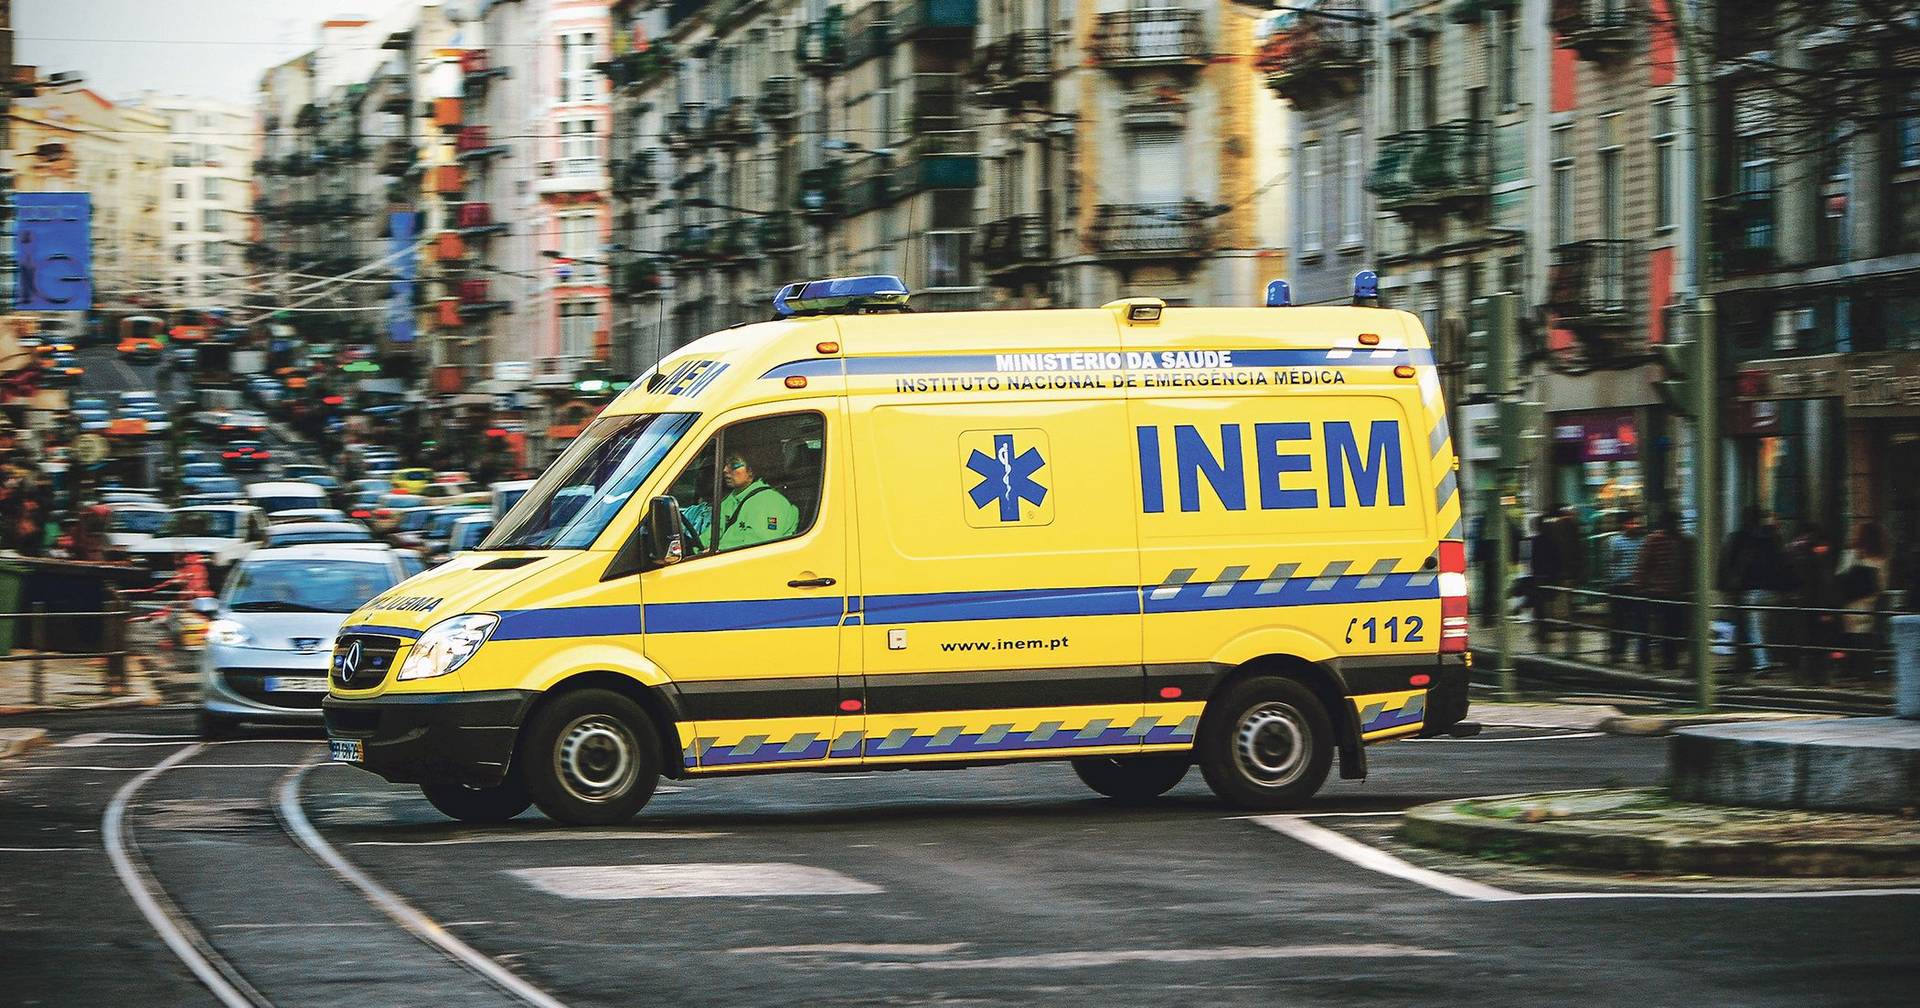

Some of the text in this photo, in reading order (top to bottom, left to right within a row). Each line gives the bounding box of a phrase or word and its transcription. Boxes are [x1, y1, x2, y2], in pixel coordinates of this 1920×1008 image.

[1126, 352, 1158, 369] DA
[896, 376, 1000, 392] INSTITUTO
[1006, 373, 1105, 390] NACIONAL
[1113, 373, 1138, 388] DE
[1274, 368, 1345, 385] MÉDICA
[1136, 420, 1406, 514] INEM
[1362, 615, 1424, 644] 112
[941, 636, 1069, 652] www.inem.pt
